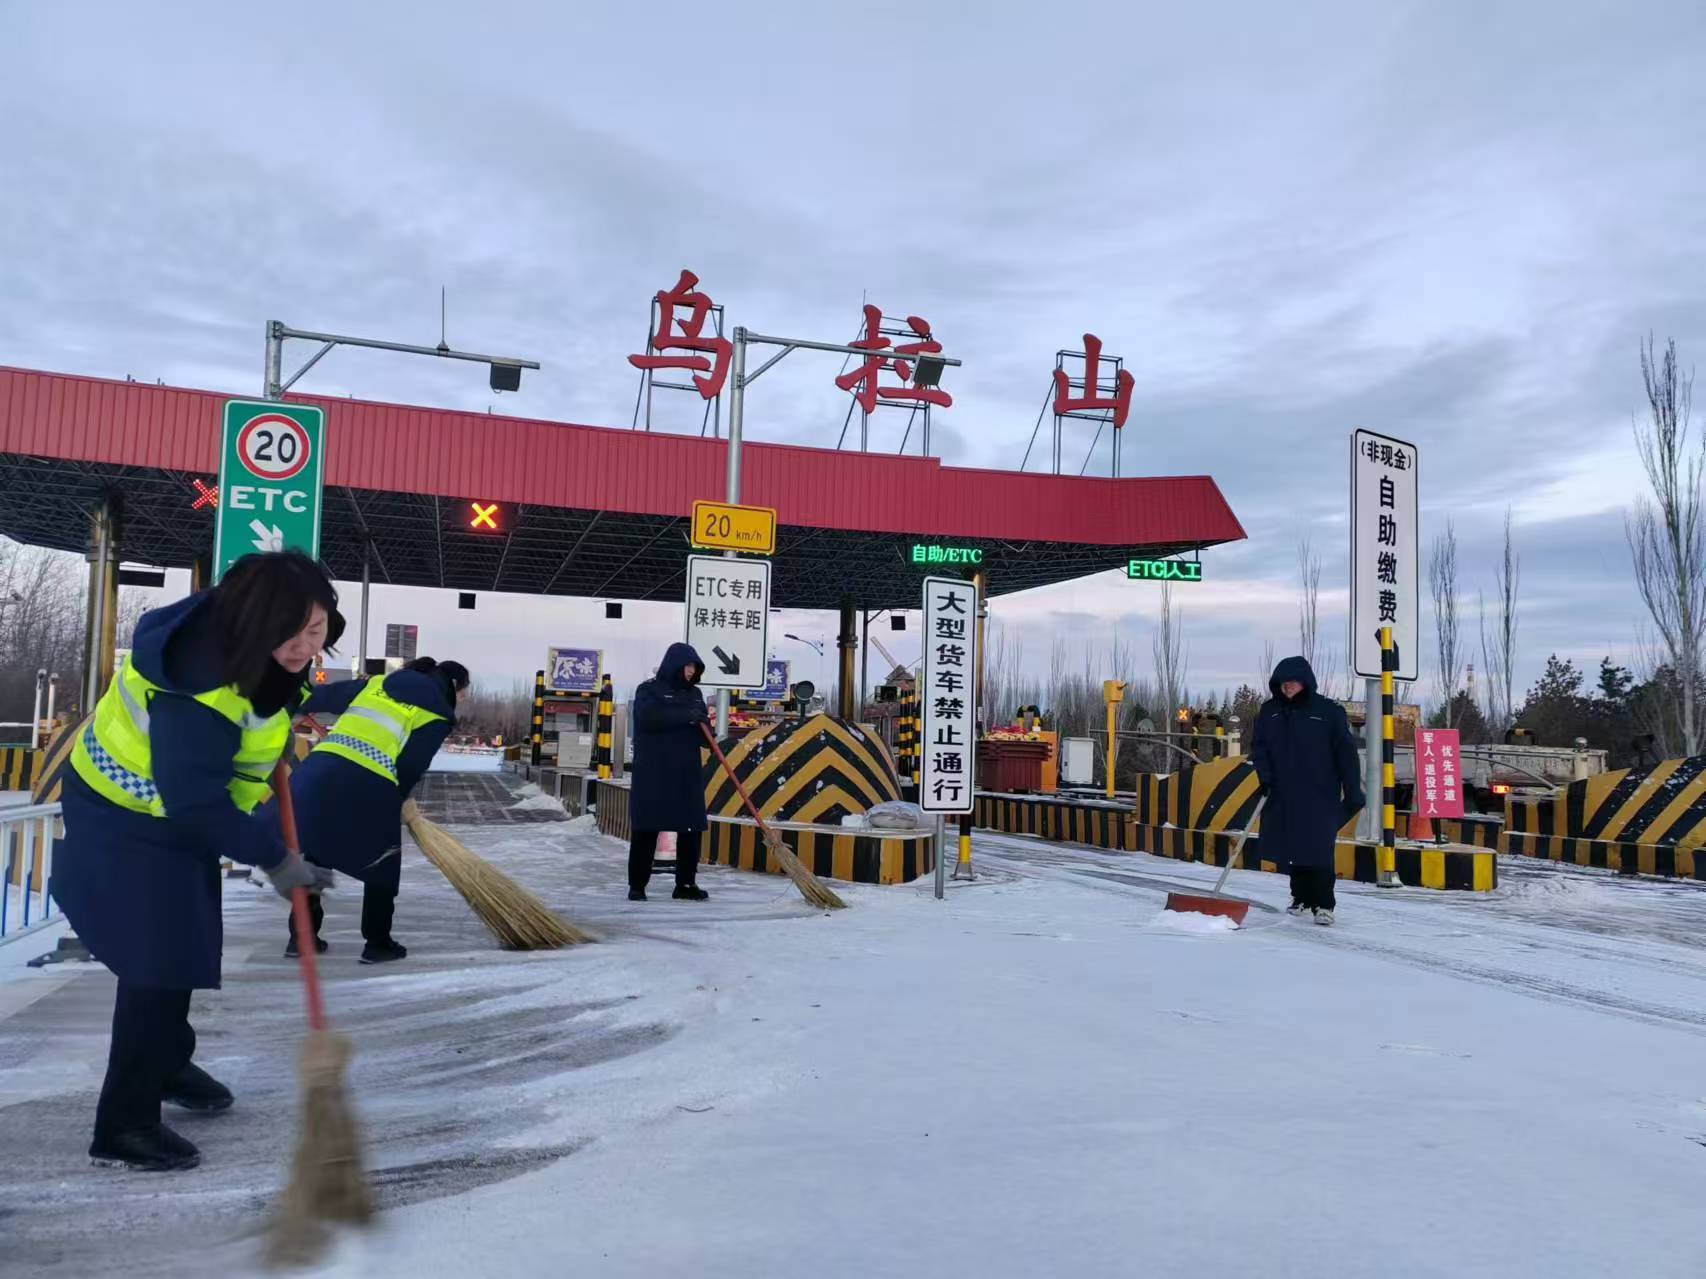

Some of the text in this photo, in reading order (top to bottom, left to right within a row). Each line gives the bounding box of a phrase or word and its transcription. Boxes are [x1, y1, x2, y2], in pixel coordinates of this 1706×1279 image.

[628, 269, 1135, 428] 乌拉山
[254, 430, 296, 463] 20
[1361, 440, 1412, 470] (非现金)
[229, 485, 308, 513] ETC
[705, 513, 762, 541] 20 km/h
[913, 544, 982, 563] 自助/ETC
[1377, 475, 1397, 623] 自助缴费
[696, 576, 762, 600] ETC专用
[694, 608, 761, 630] 保持车距
[933, 591, 966, 802] 大型货车禁止通行
[1442, 745, 1456, 801] 优先通道
